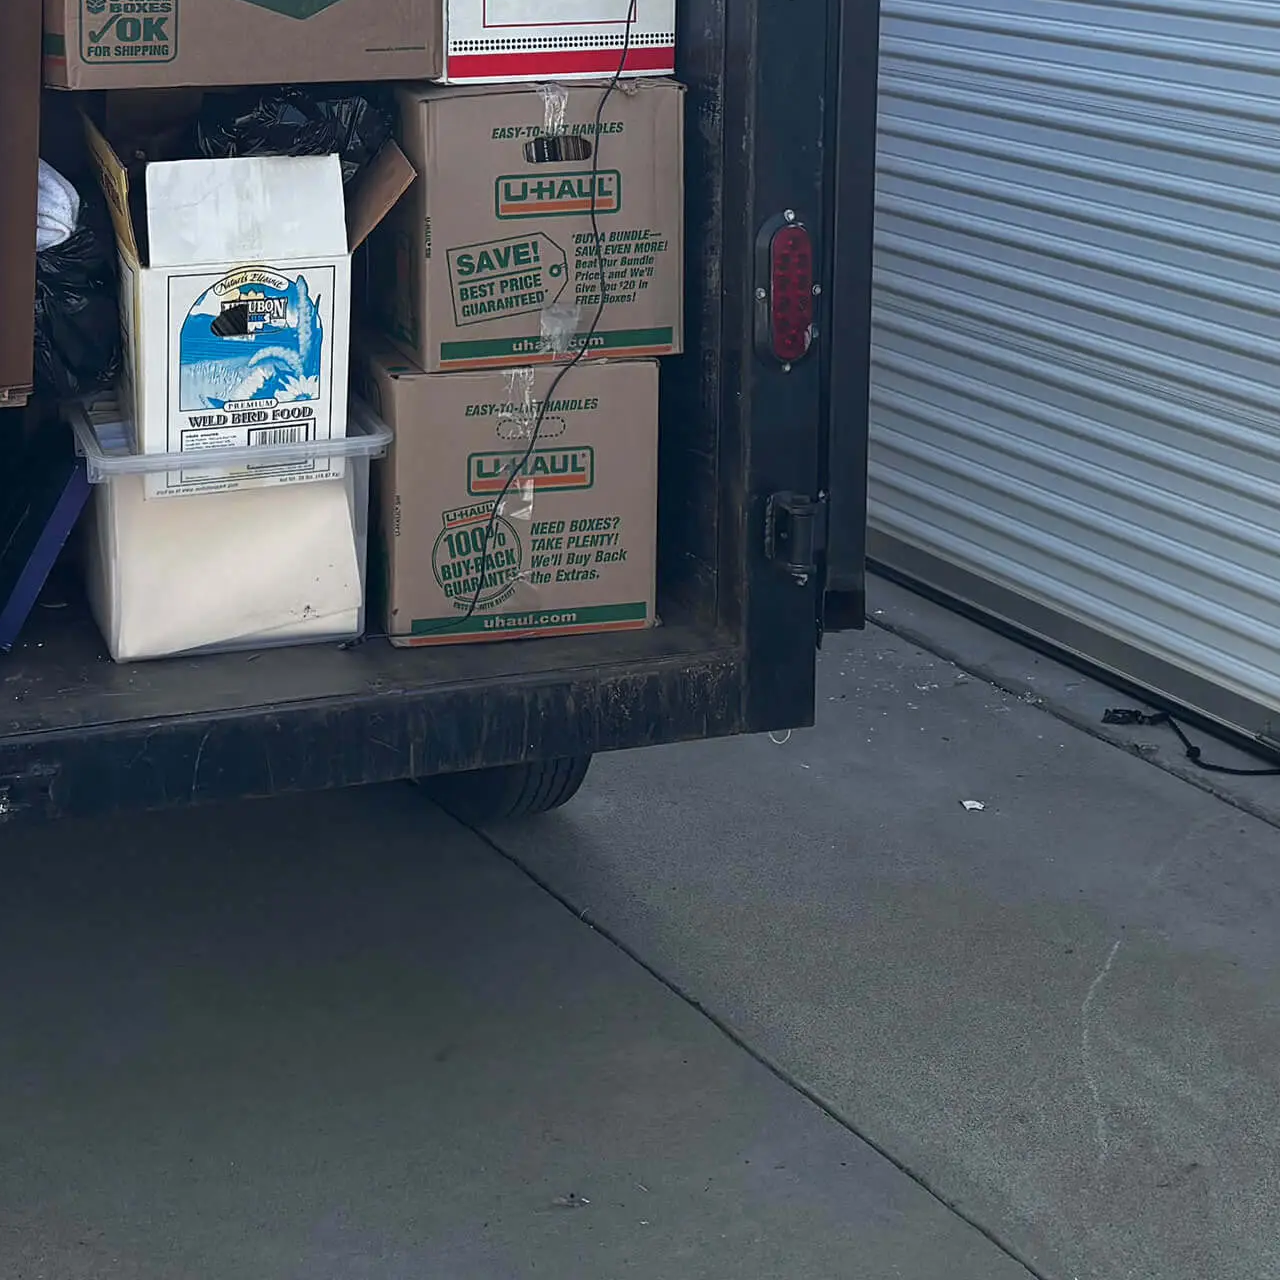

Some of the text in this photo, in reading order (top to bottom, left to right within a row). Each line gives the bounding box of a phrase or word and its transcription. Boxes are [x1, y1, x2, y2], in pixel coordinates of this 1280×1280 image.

[109, 3, 172, 13] BOXES
[116, 17, 169, 42] OK
[87, 44, 169, 57] FOR SHIPPING
[504, 178, 613, 202] U-HAUL
[604, 243, 631, 255] EVEN
[634, 240, 668, 254] MORE!
[457, 240, 540, 276] SAVE!
[575, 259, 597, 269] Beat
[619, 255, 654, 266] Bundle
[608, 268, 627, 279] and
[631, 266, 654, 278] We'll
[460, 273, 542, 301] BEST PRICE
[575, 283, 596, 294] Give
[575, 291, 636, 305] FREE Boxes!
[228, 400, 273, 410] PREMIUM
[188, 406, 314, 428] WILD BIRD FOOD
[446, 503, 494, 522] U-HAUL
[530, 516, 621, 536] NEED BOXES?
[443, 521, 507, 559] 100%
[530, 533, 619, 552] TAKE PLENTY!
[531, 548, 628, 568] We'll Buy Back
[530, 568, 600, 585] the Extras.
[483, 612, 577, 629] uhaul.com
